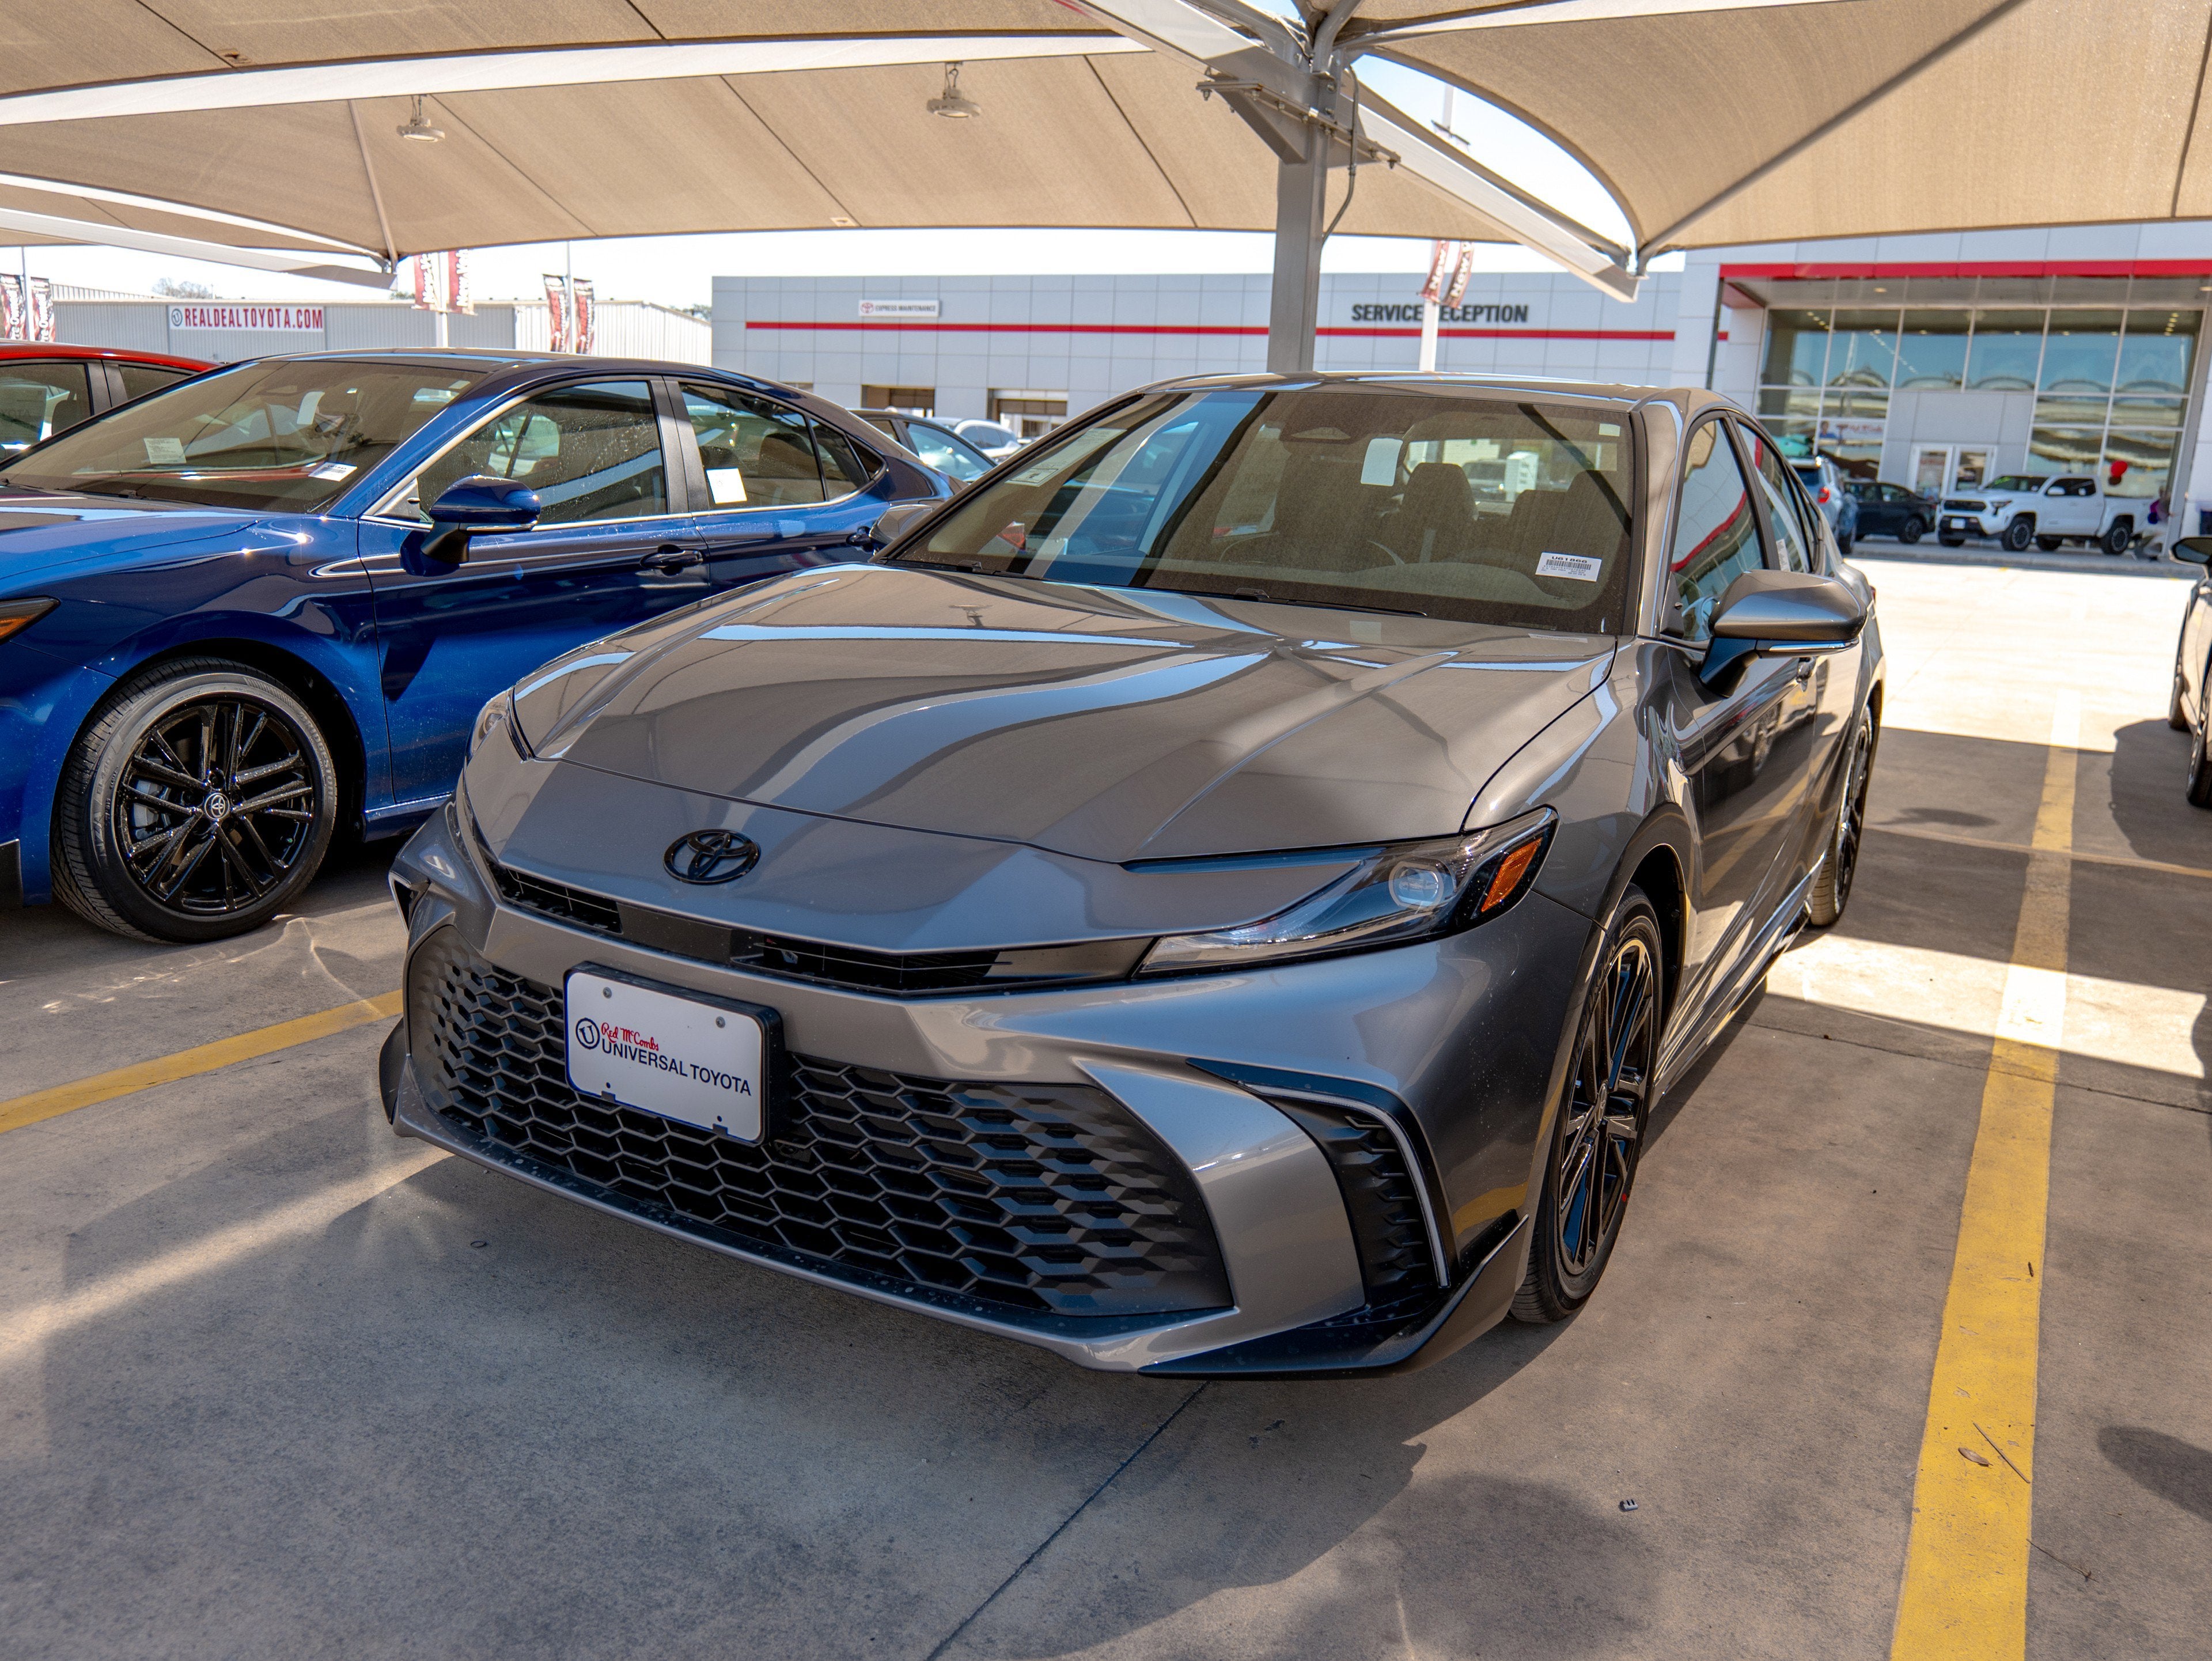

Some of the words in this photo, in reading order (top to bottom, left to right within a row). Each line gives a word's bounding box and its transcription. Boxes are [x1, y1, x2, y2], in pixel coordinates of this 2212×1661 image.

[1429, 249, 1446, 290] New
[1450, 257, 1469, 297] New
[184, 308, 323, 329] REALDEALTOYOTA.COM
[1351, 304, 1423, 321] SERVICE
[1440, 304, 1529, 323] ECEPTION
[297, 712, 334, 804] BRIDGESTONE
[601, 1022, 619, 1043] Red
[620, 1027, 659, 1051] McCombs
[601, 1038, 688, 1077] UNIVERSAL
[690, 1064, 752, 1096] TOYOTA
